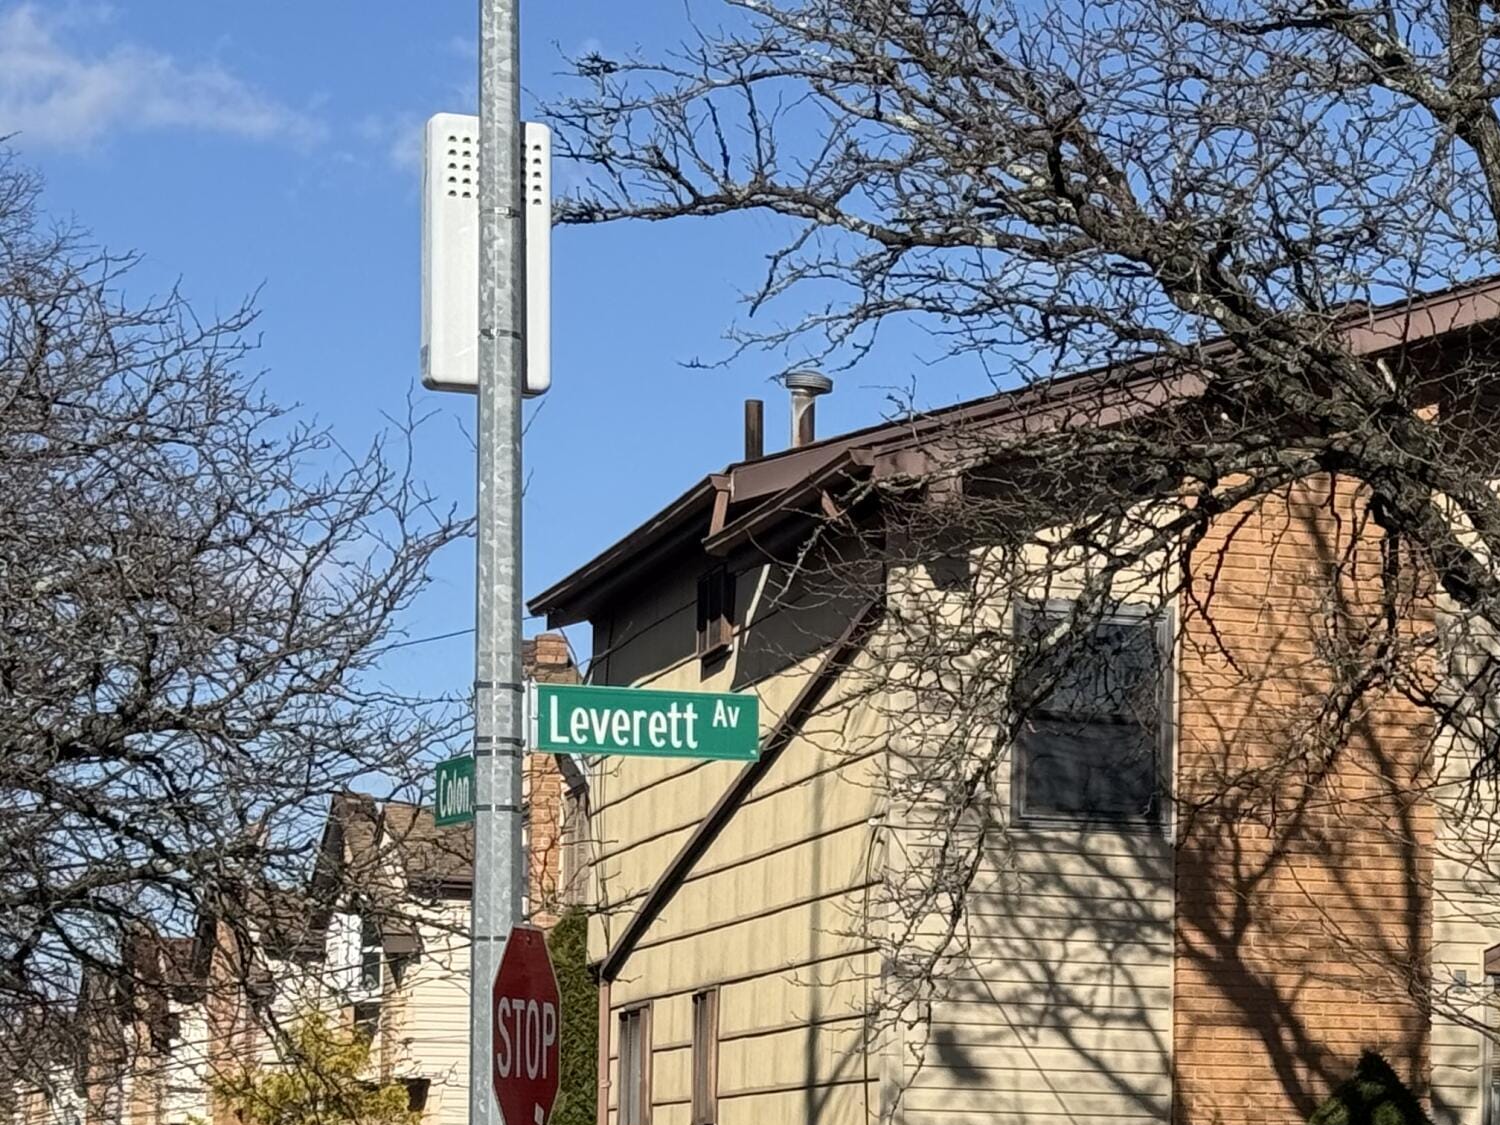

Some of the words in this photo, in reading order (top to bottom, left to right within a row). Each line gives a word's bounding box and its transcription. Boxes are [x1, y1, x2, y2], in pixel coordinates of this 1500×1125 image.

[550, 695, 699, 749] Leverett
[712, 699, 741, 728] Av
[439, 769, 470, 818] Colon
[497, 996, 556, 1080] STOP
